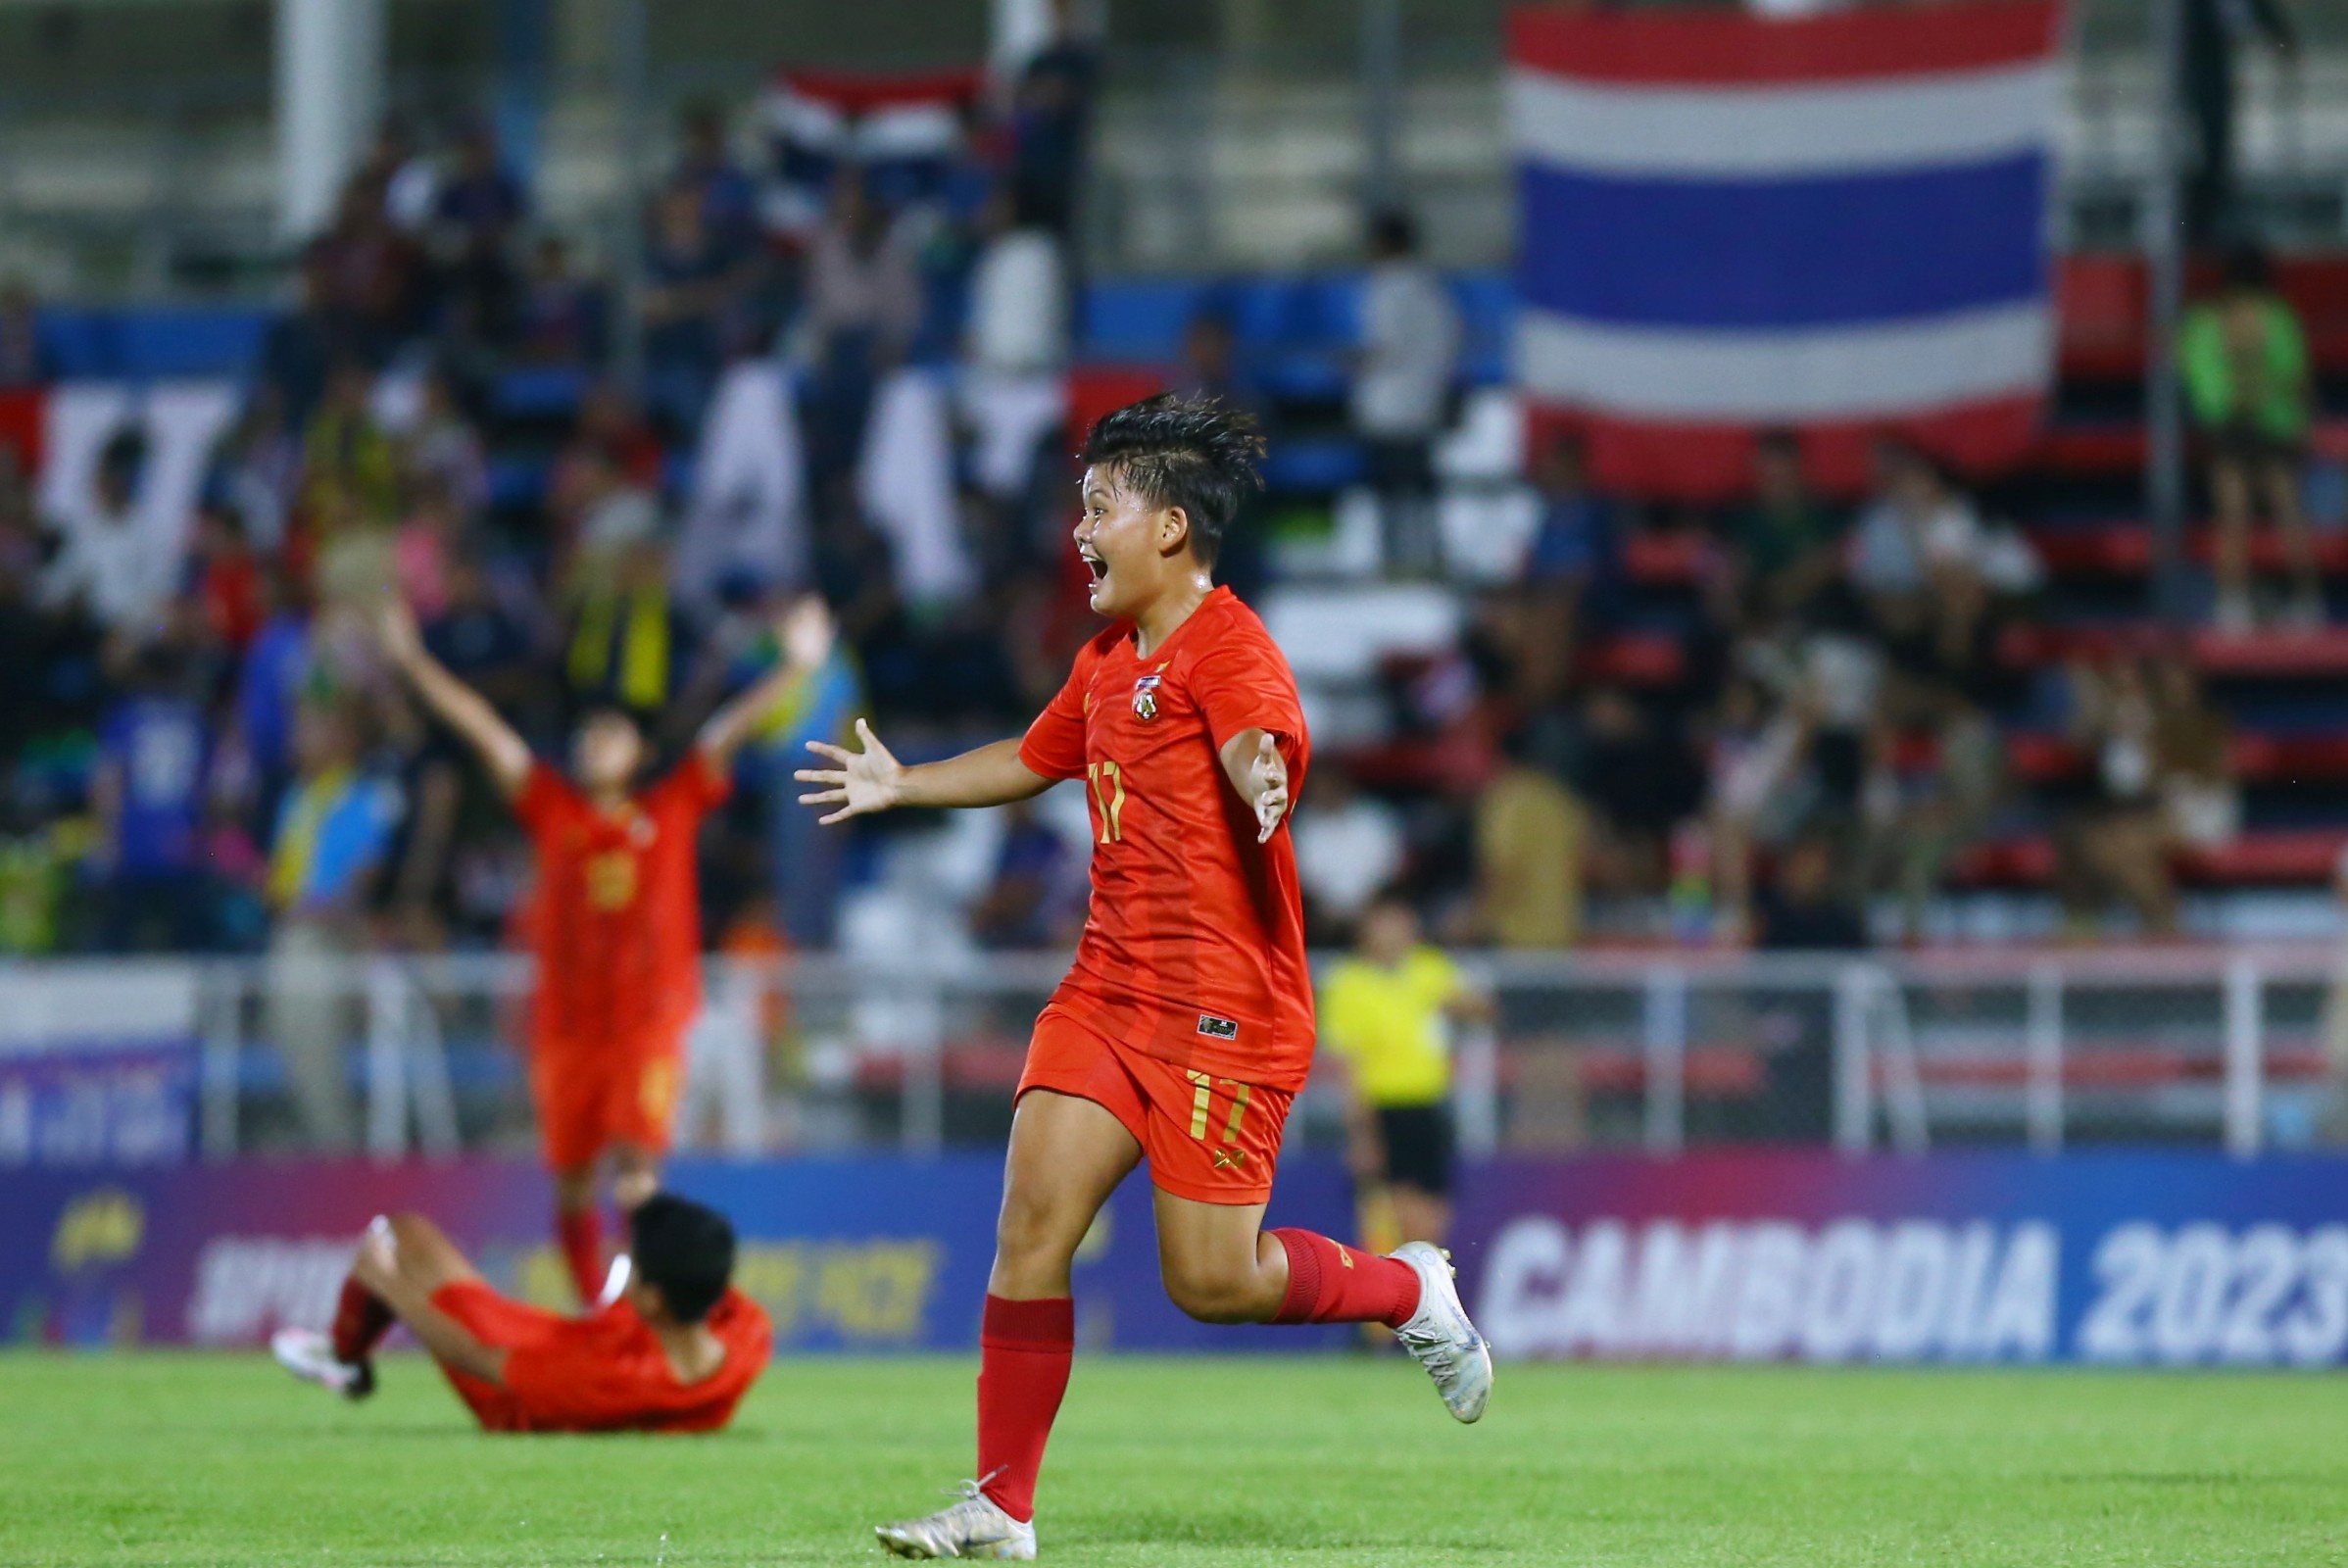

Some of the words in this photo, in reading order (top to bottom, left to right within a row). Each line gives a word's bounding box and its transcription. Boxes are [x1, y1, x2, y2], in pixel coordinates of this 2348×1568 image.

[1088, 760, 1126, 845] 17
[1186, 1068, 1250, 1144] 17
[1480, 1217, 2058, 1358] CAMBODIA
[2076, 1221, 2348, 1362] 2023
